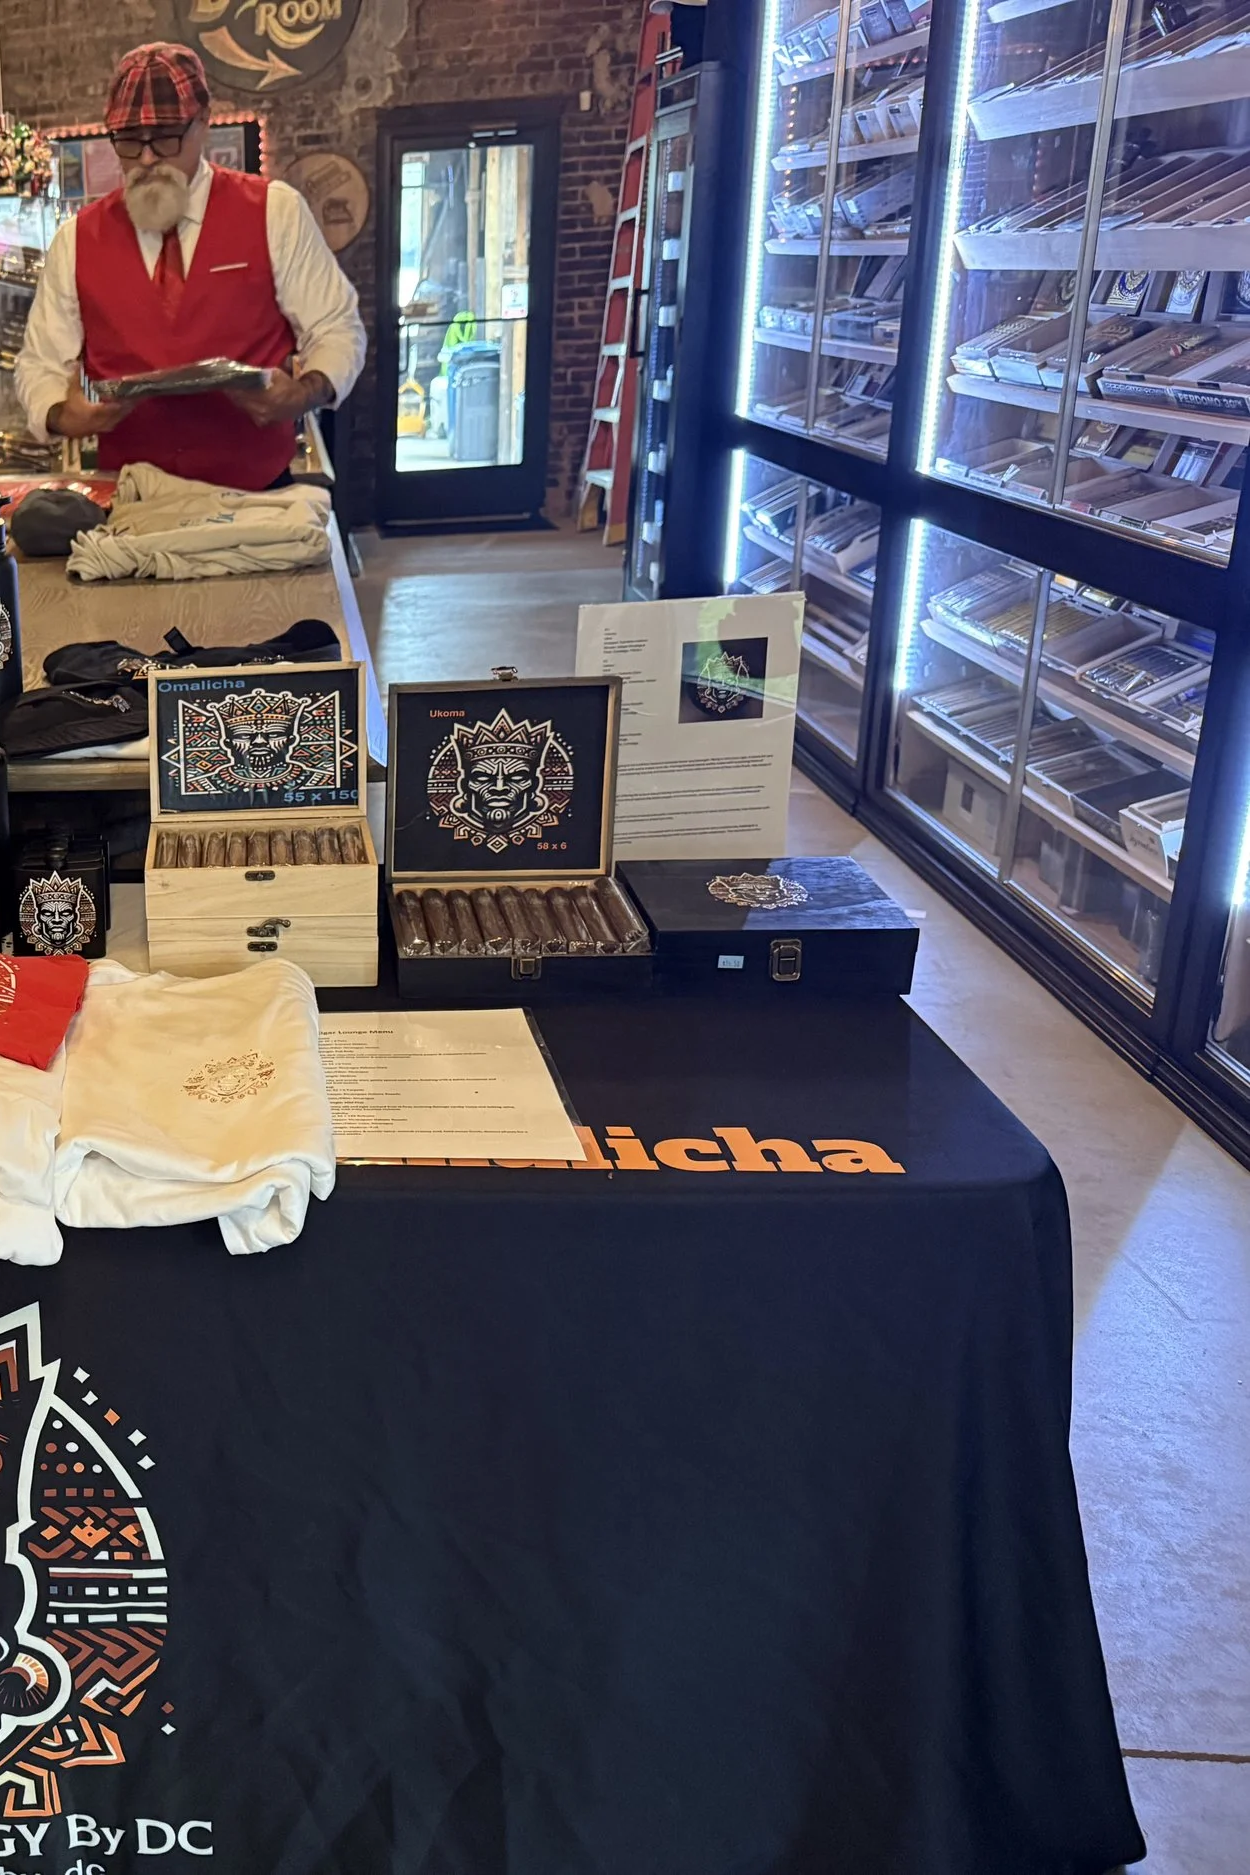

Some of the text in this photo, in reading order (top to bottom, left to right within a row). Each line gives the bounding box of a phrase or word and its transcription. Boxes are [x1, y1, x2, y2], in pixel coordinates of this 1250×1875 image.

[255, 0, 342, 36] ROOM
[158, 679, 246, 693] Omalicha
[428, 709, 466, 719] Ukoma
[284, 789, 358, 803] 55 x 150
[536, 842, 549, 851] 58
[560, 842, 567, 850] 6
[66, 1813, 126, 1856] By
[135, 1818, 214, 1856] DC
